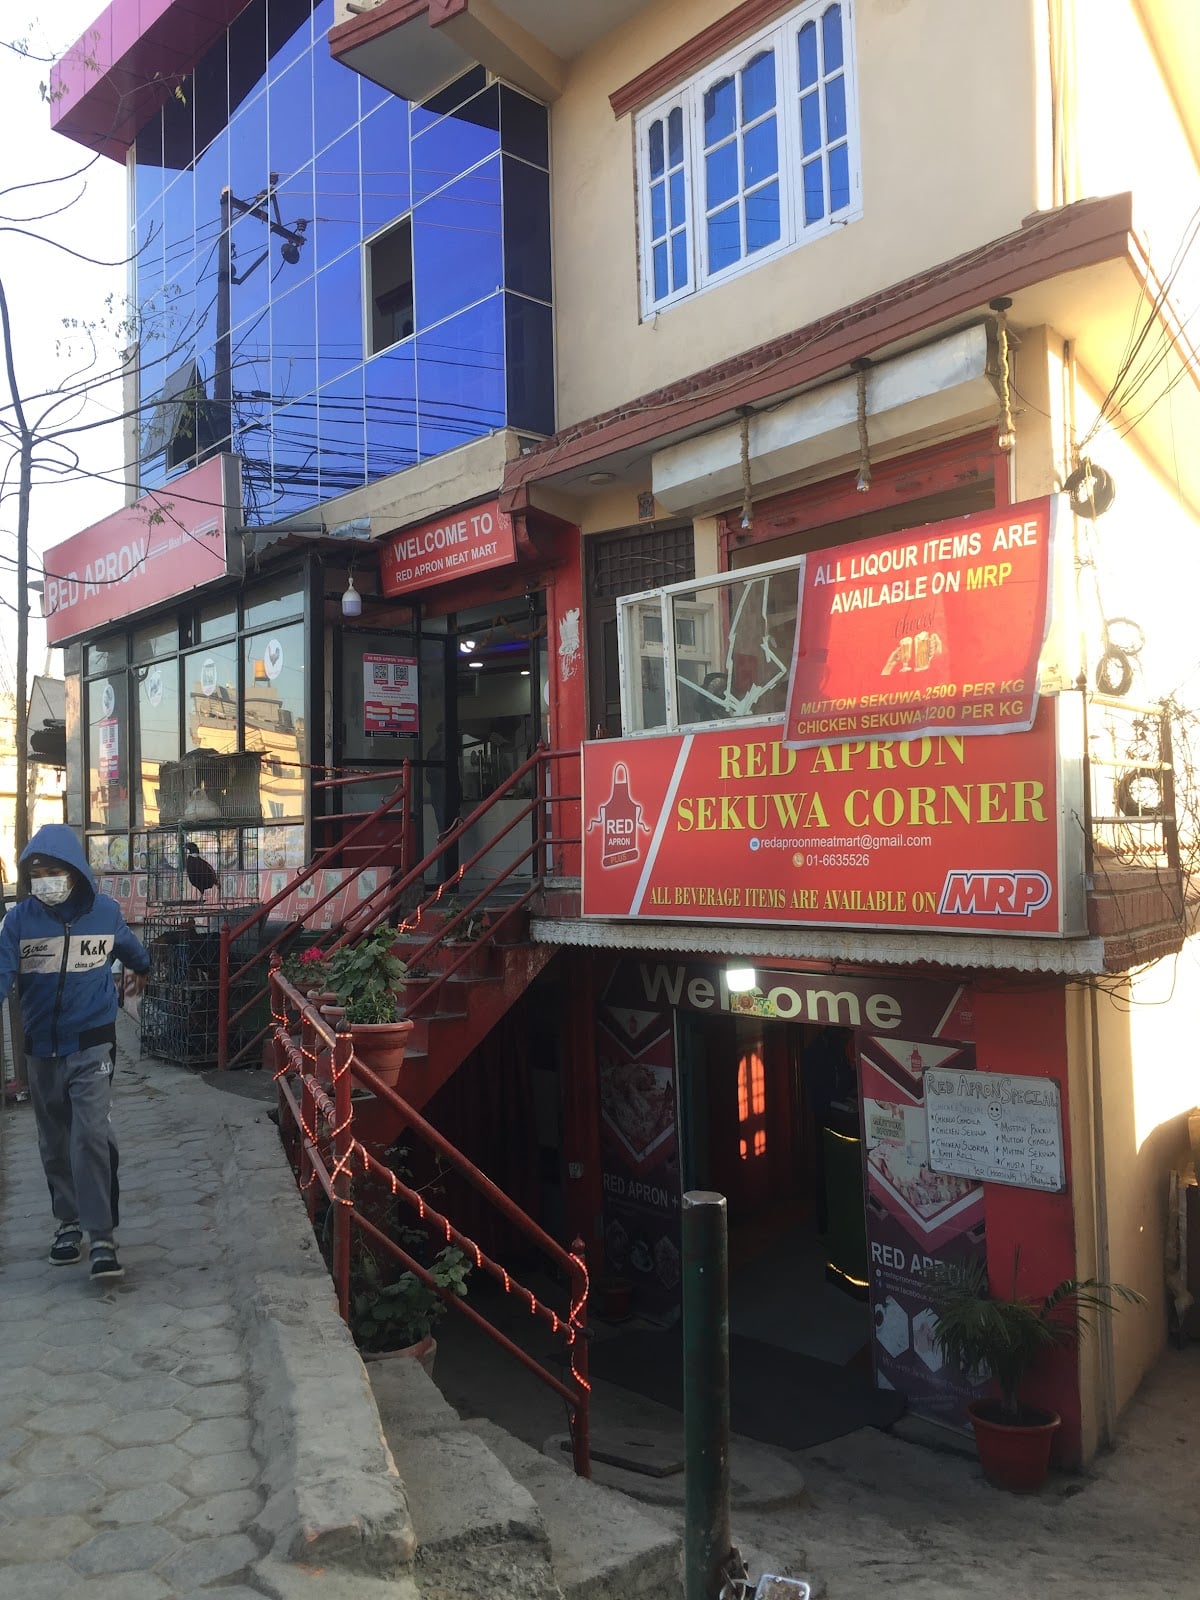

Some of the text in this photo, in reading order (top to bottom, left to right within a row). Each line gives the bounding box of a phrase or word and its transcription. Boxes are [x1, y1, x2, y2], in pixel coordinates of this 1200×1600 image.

[393, 512, 493, 562] WELCOME TO
[814, 521, 1038, 586] ALL LIQOUR ITEMS ARE
[48, 537, 147, 613] RED APRON
[395, 542, 498, 583] RED APRON MEAT MART
[830, 562, 1012, 615] AVAILABLE ON MRP
[800, 696, 858, 715] MUTTON
[962, 681, 996, 698] PER
[1000, 679, 1025, 694] KG
[797, 715, 857, 735] CHICKEN
[961, 703, 995, 719] PER
[999, 700, 1024, 716] KG
[718, 736, 966, 780] RED APRON
[677, 780, 1048, 832] SEKUWA CORNER
[606, 819, 634, 835] RED
[608, 837, 631, 846] APRON
[760, 834, 932, 850] redaproonmeatmart@gmail.com
[610, 854, 627, 864] PLUS
[806, 854, 870, 867] 01-6635526
[650, 870, 1052, 916] ALL BEVERAGE ITEMS ARE AVAILABLE ON MRP
[80, 940, 107, 956] K&K
[639, 963, 902, 1030] Welome
[926, 1073, 954, 1096] RED
[957, 1074, 1000, 1099] APRON
[603, 1173, 625, 1194] RED
[627, 1180, 669, 1208] APRON
[871, 1241, 906, 1270] RED
